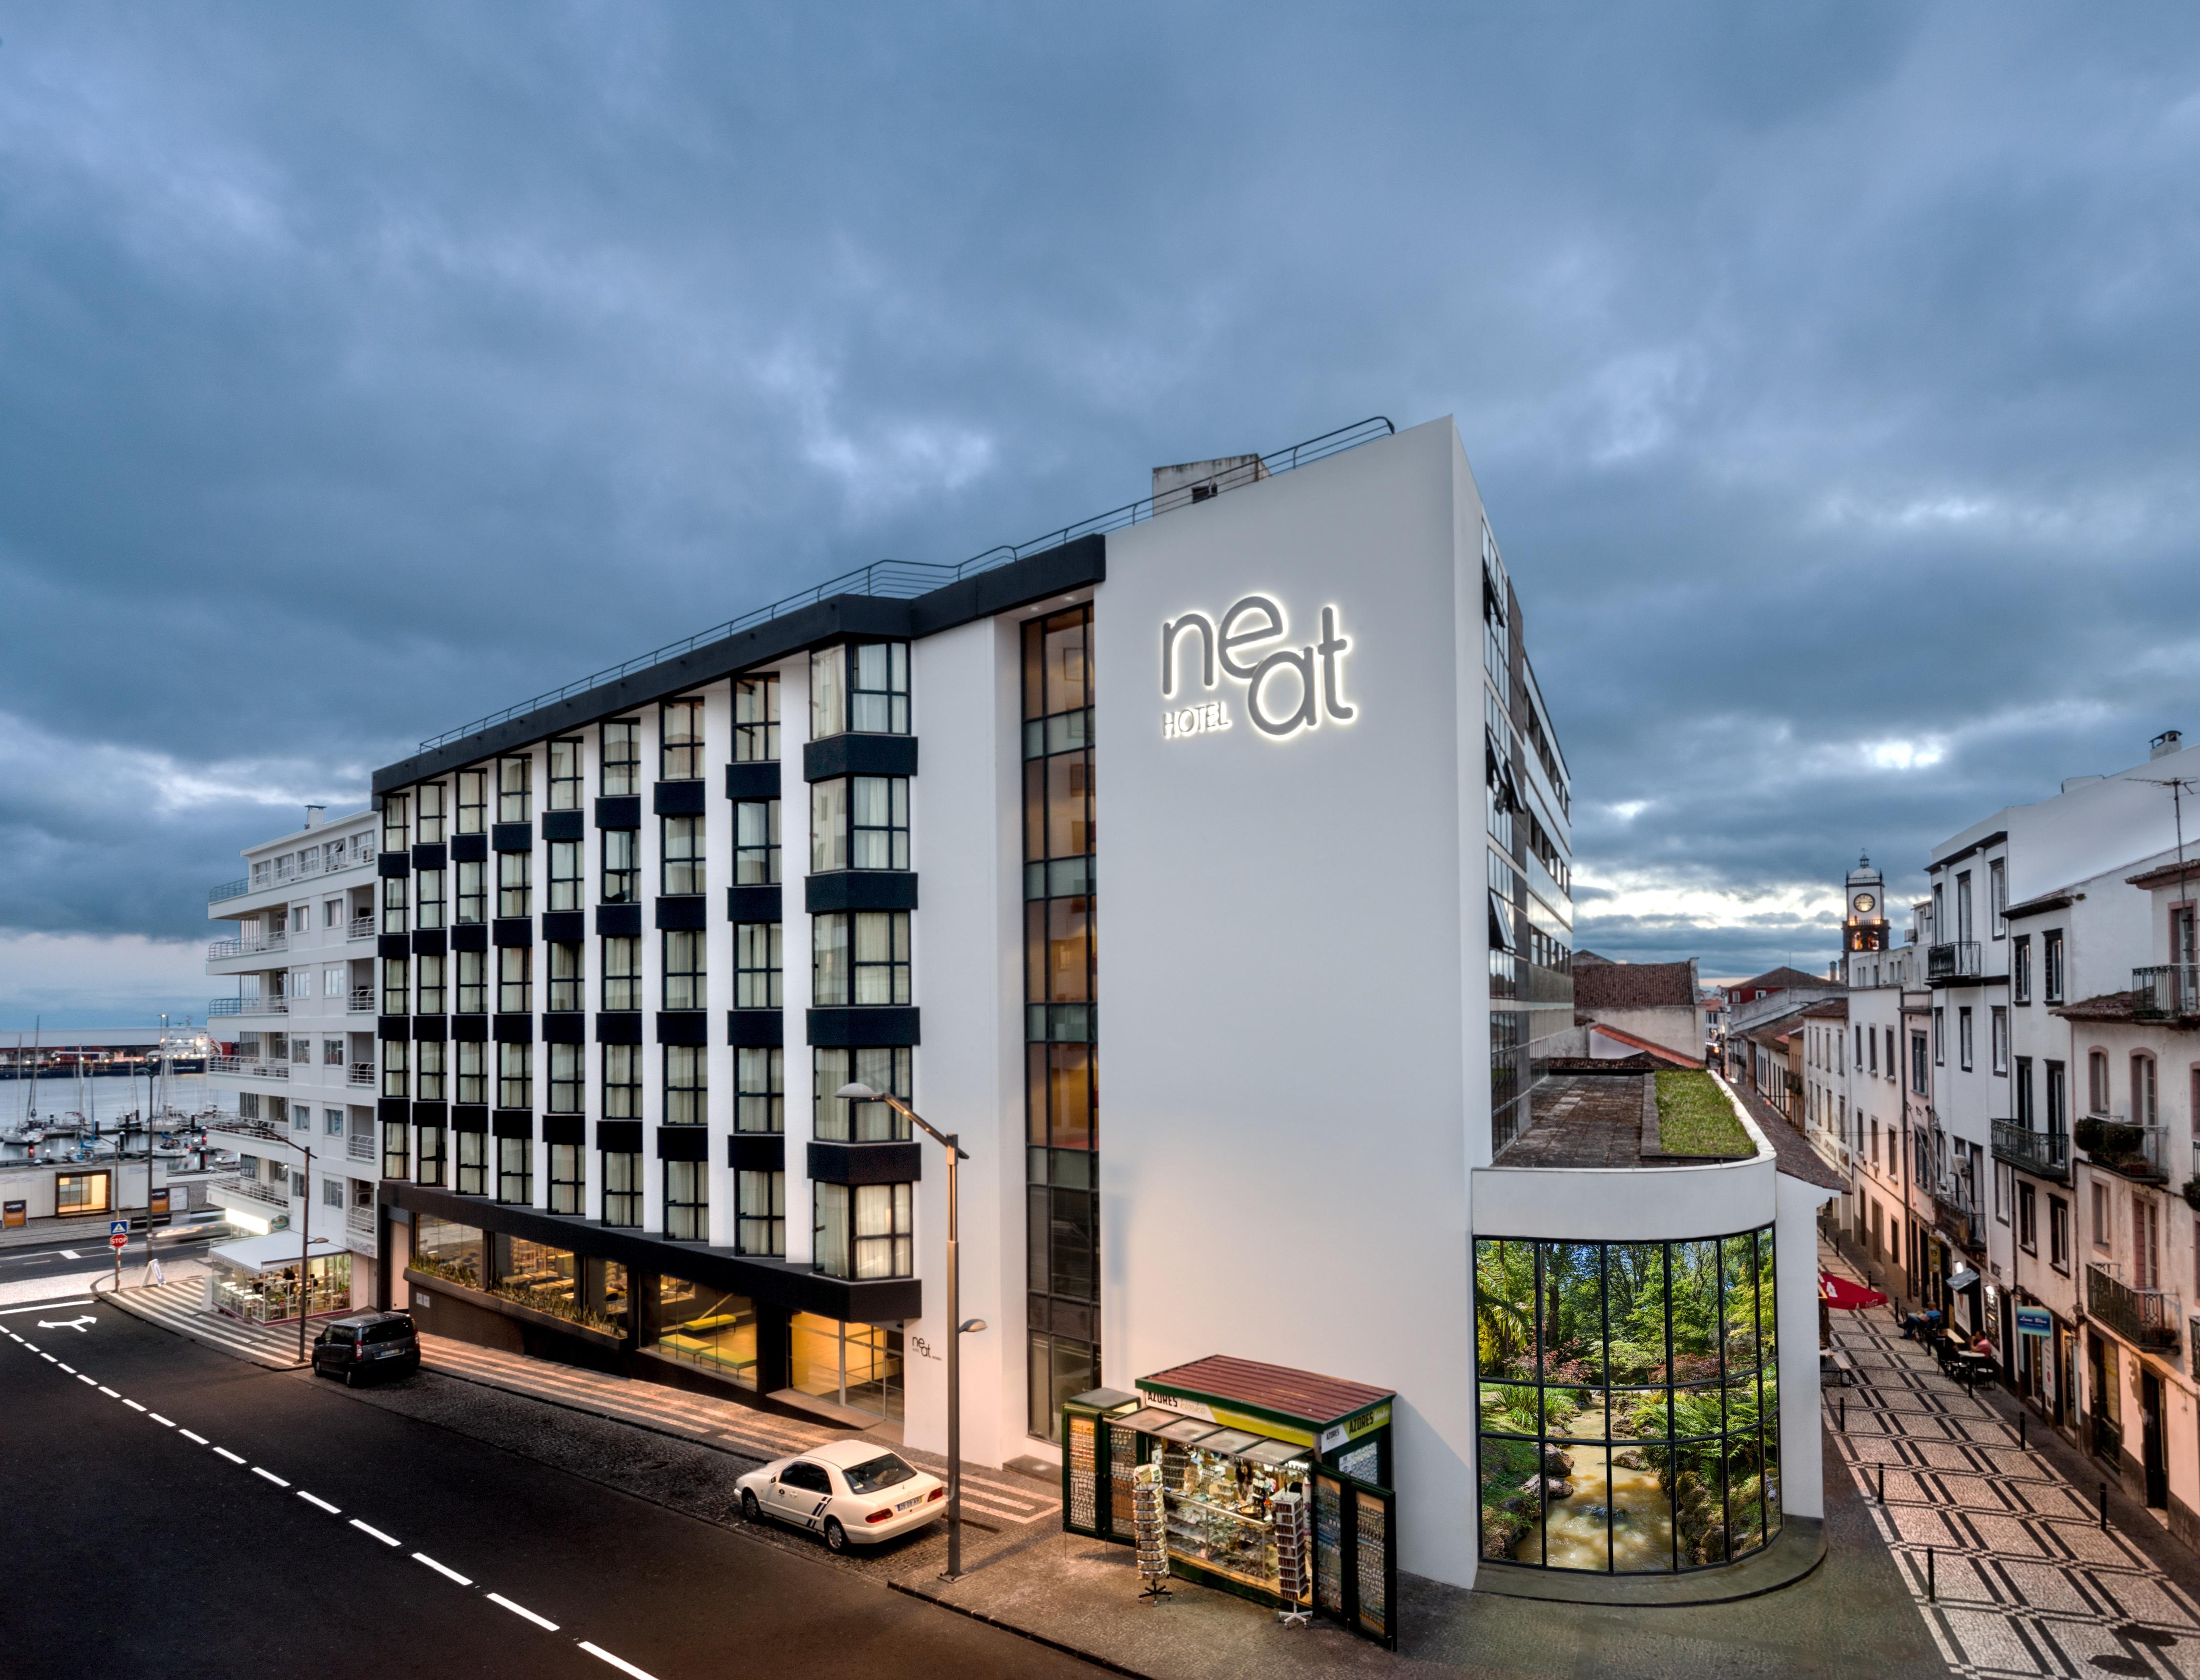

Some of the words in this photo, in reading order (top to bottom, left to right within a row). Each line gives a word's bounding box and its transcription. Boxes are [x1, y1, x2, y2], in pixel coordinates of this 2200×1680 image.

[1162, 596, 1355, 736] neat
[1163, 702, 1232, 738] HOTEL
[912, 1336, 931, 1358] neat
[1349, 1411, 1373, 1434] AZORES
[1326, 1429, 1339, 1440] AZORES
